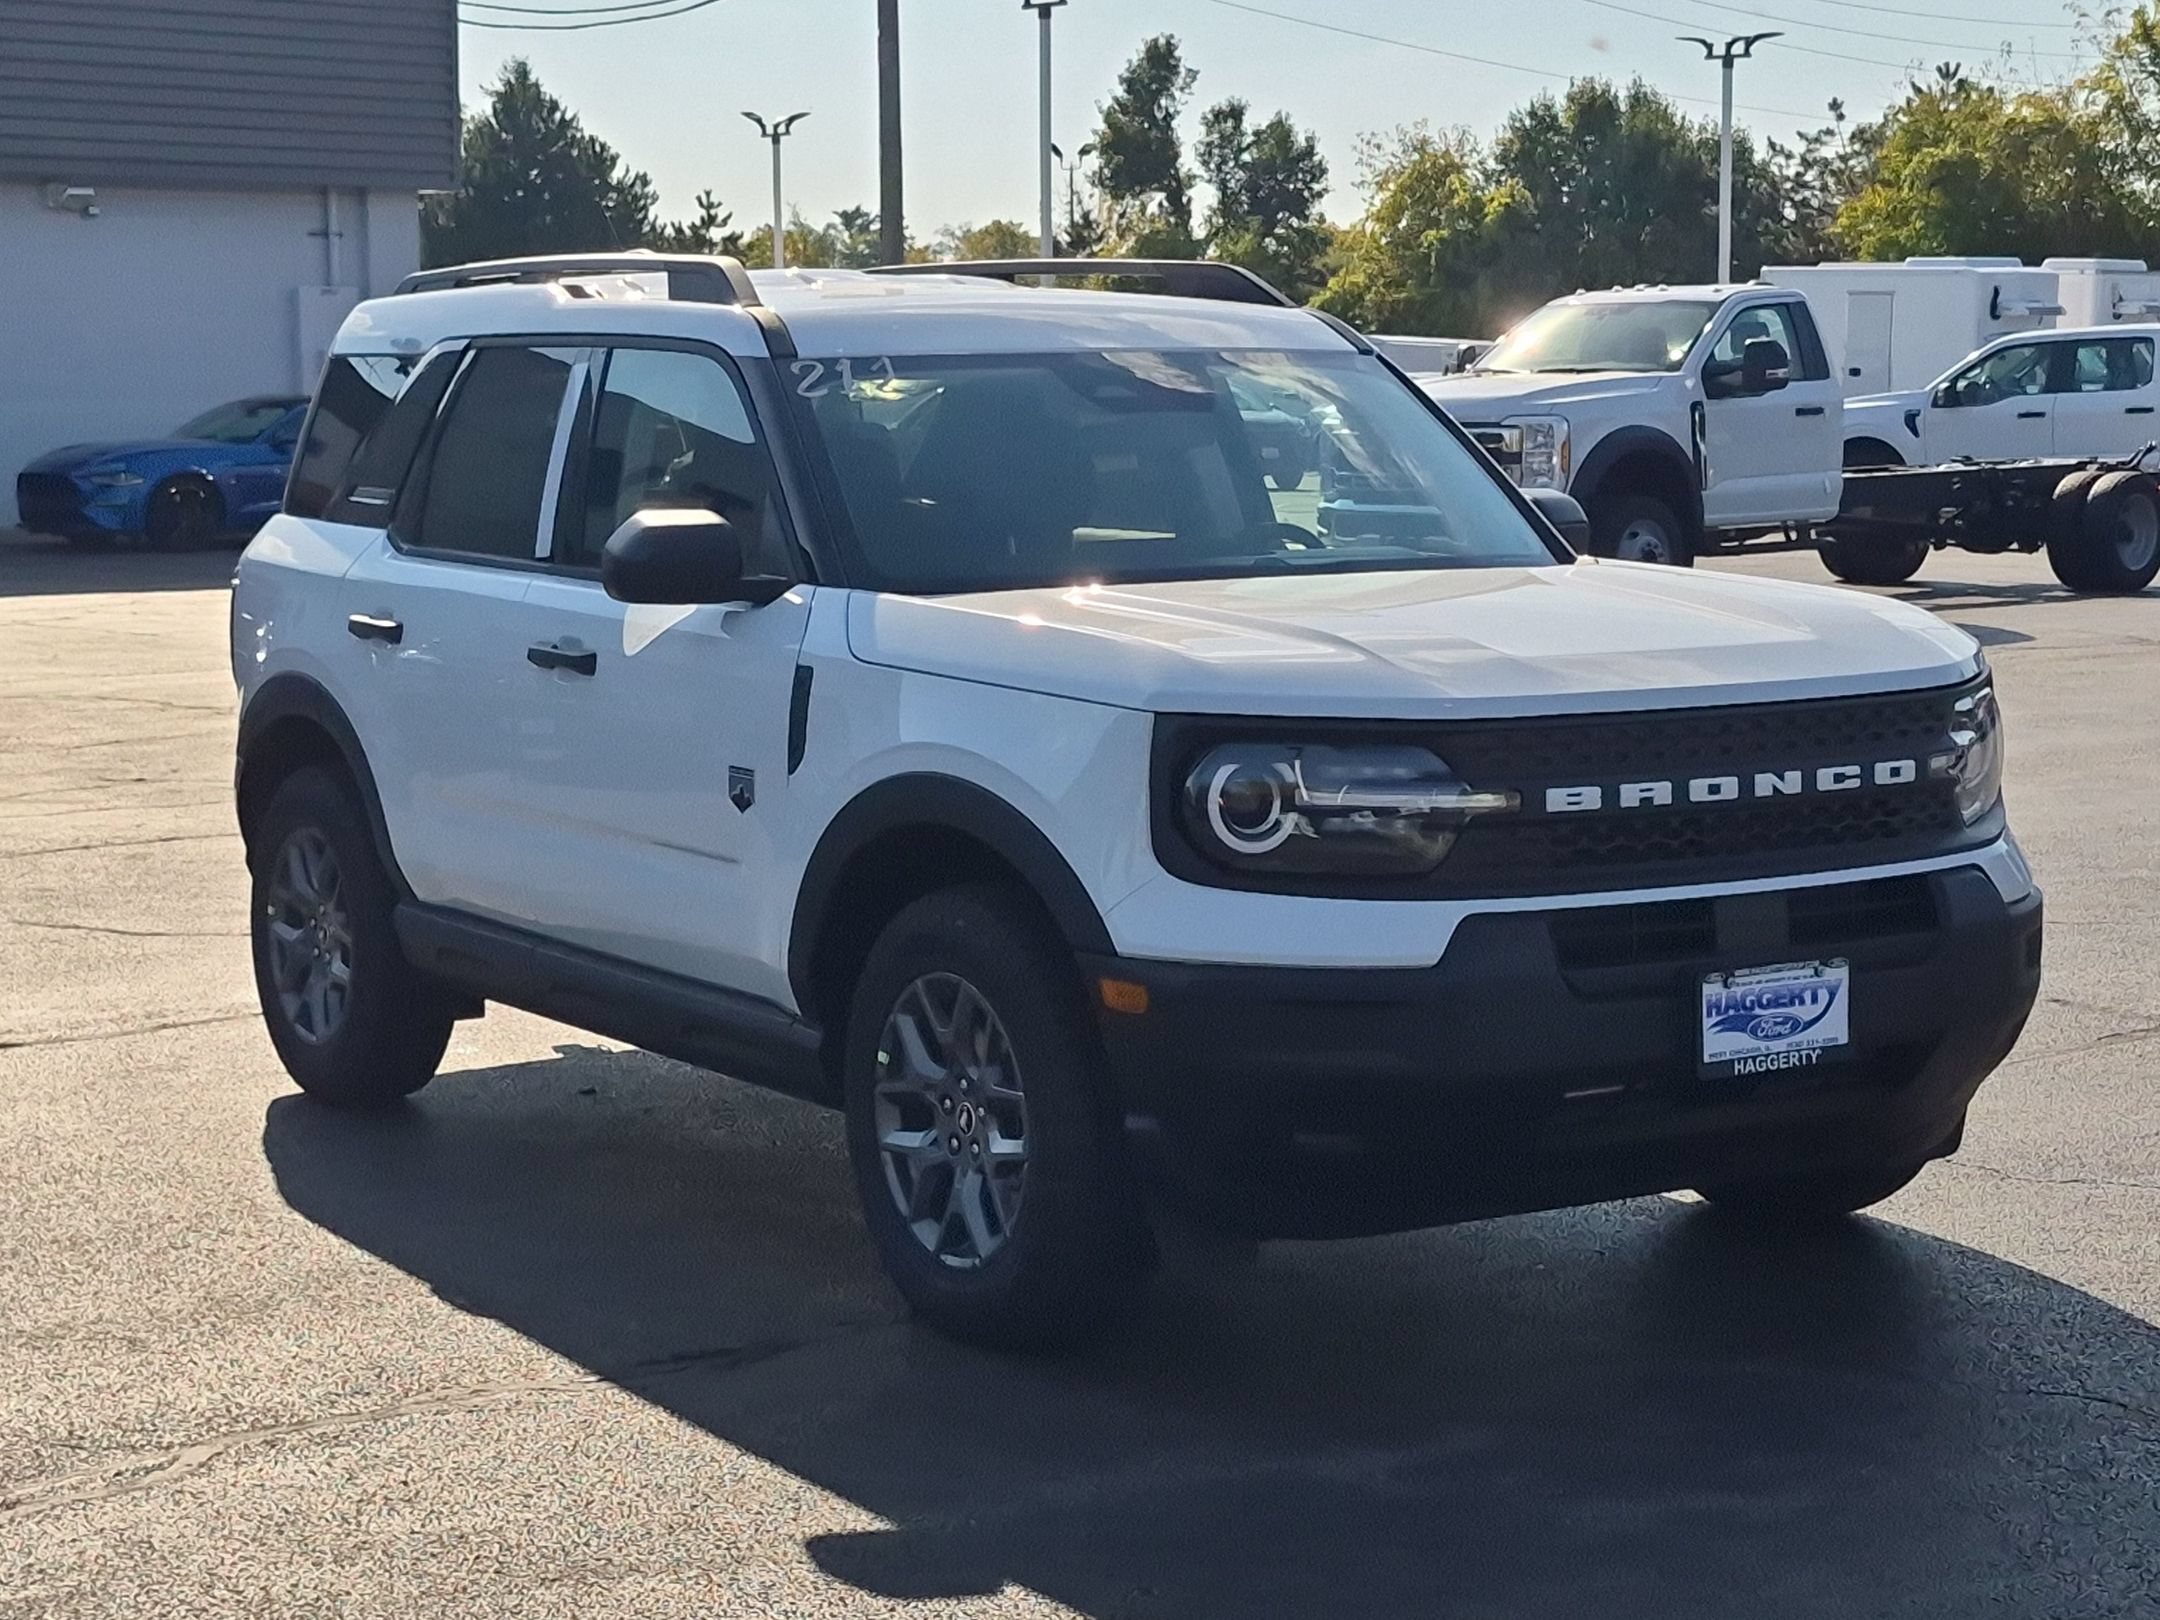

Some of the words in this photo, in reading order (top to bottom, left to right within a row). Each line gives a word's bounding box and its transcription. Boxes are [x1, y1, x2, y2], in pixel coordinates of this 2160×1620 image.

[1545, 759, 1916, 813] BRONCO
[1705, 979, 1843, 1019] HAGGERTY
[1757, 1017, 1793, 1037] Ford
[1734, 1049, 1820, 1076] HAGGERTY
